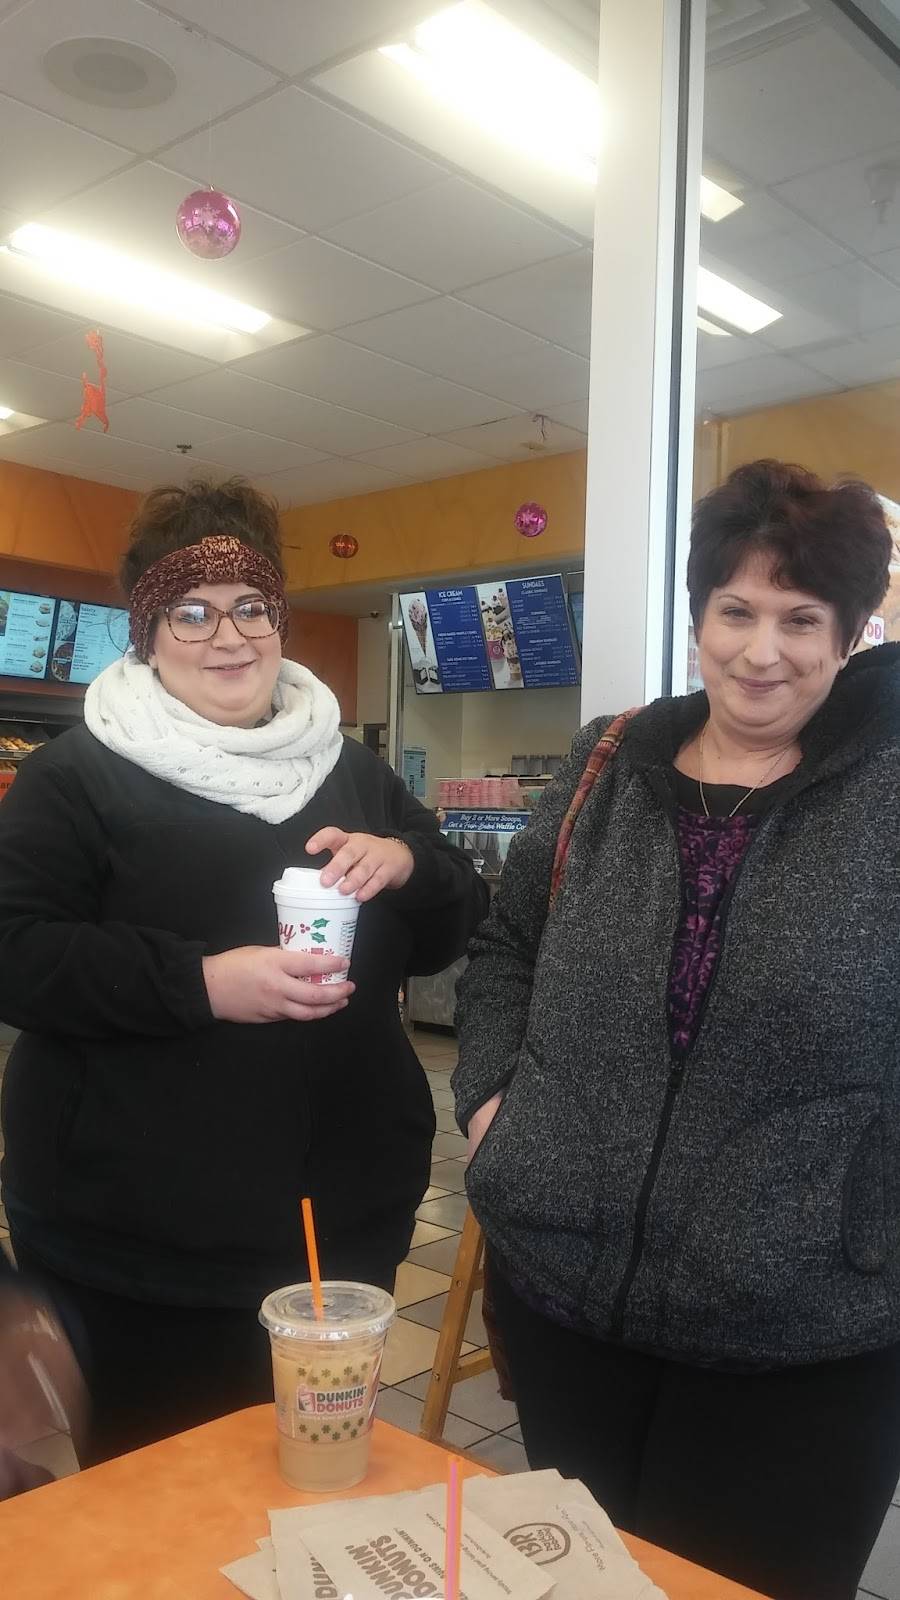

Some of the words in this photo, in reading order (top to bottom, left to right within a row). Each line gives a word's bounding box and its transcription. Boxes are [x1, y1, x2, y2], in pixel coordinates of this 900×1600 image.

[522, 580, 545, 589] SUNDAES
[446, 590, 463, 598] CREAM
[460, 814, 470, 822] Buy
[448, 821, 458, 829] Get
[496, 822, 514, 830] Waffle
[316, 1385, 367, 1402] DUNKIN'
[316, 1397, 364, 1412] DONUTS
[418, 1552, 432, 1563] ON
[369, 1535, 438, 1598] DONUTS
